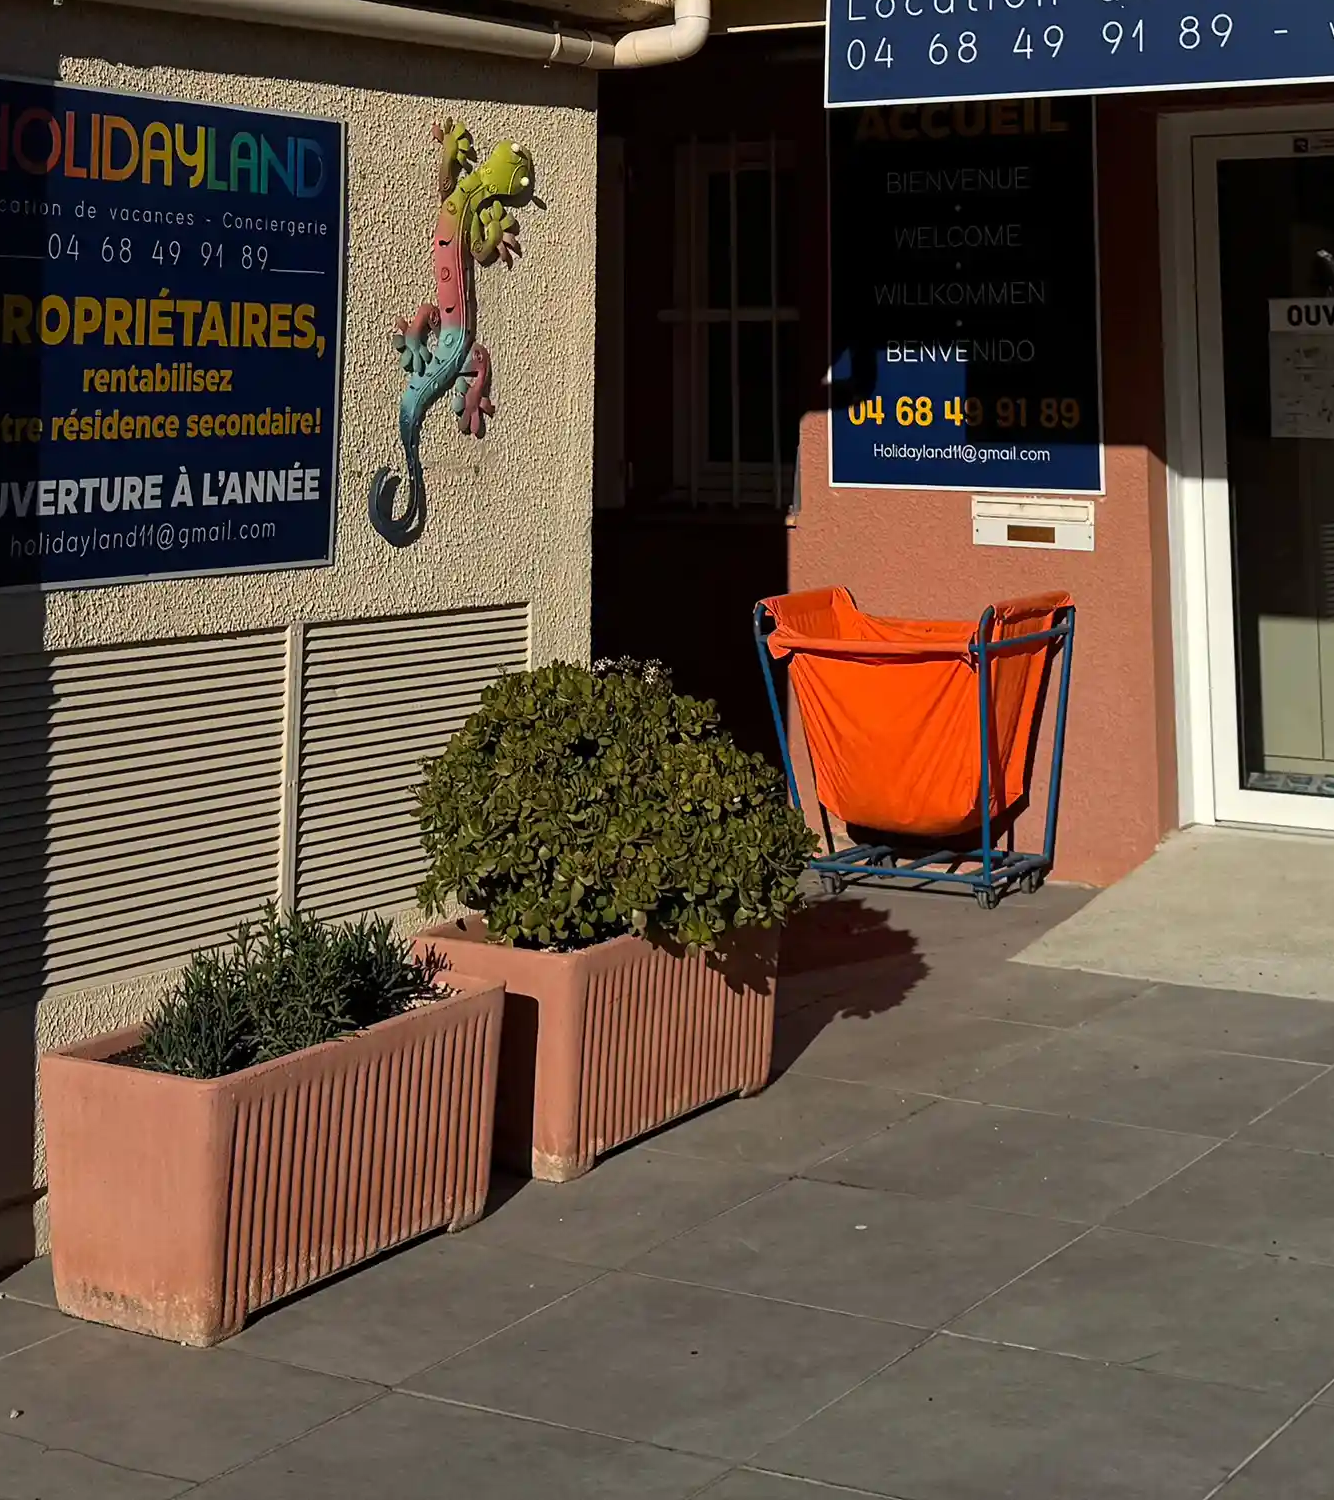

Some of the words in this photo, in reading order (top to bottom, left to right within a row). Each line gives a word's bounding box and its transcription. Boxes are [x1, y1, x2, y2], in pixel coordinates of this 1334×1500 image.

[847, 37, 895, 71] 04
[928, 30, 979, 66] 68
[1013, 24, 1065, 60] 49
[1102, 18, 1145, 55] 91
[1179, 13, 1234, 50] 89
[854, 97, 1070, 142] ACCUEIL
[886, 165, 1033, 194] BIENVENUE
[75, 201, 97, 219] de
[110, 206, 195, 226] vacances
[222, 211, 328, 237] Conciergerie
[48, 233, 80, 261] 04
[101, 236, 132, 263] 68
[151, 239, 181, 265] 49
[201, 241, 223, 268] 91
[241, 245, 268, 270] 89
[893, 223, 1024, 250] WELCOME
[874, 280, 1046, 306] WILLKOMMEN
[886, 338, 1036, 363] BENVENIDO
[82, 362, 233, 393] rentabilisez
[51, 408, 180, 441] résidence
[186, 406, 322, 437] secondaire!
[848, 396, 886, 426] 04
[895, 396, 934, 427] 68
[944, 396, 984, 427] 49
[995, 396, 1028, 428] 91
[1039, 396, 1081, 430] 89
[873, 443, 1051, 463] Holidayland11@gmail.com
[171, 466, 194, 508] À
[203, 461, 321, 507] L'ANNÉE
[10, 520, 276, 558] holidayland11@gmail.com
